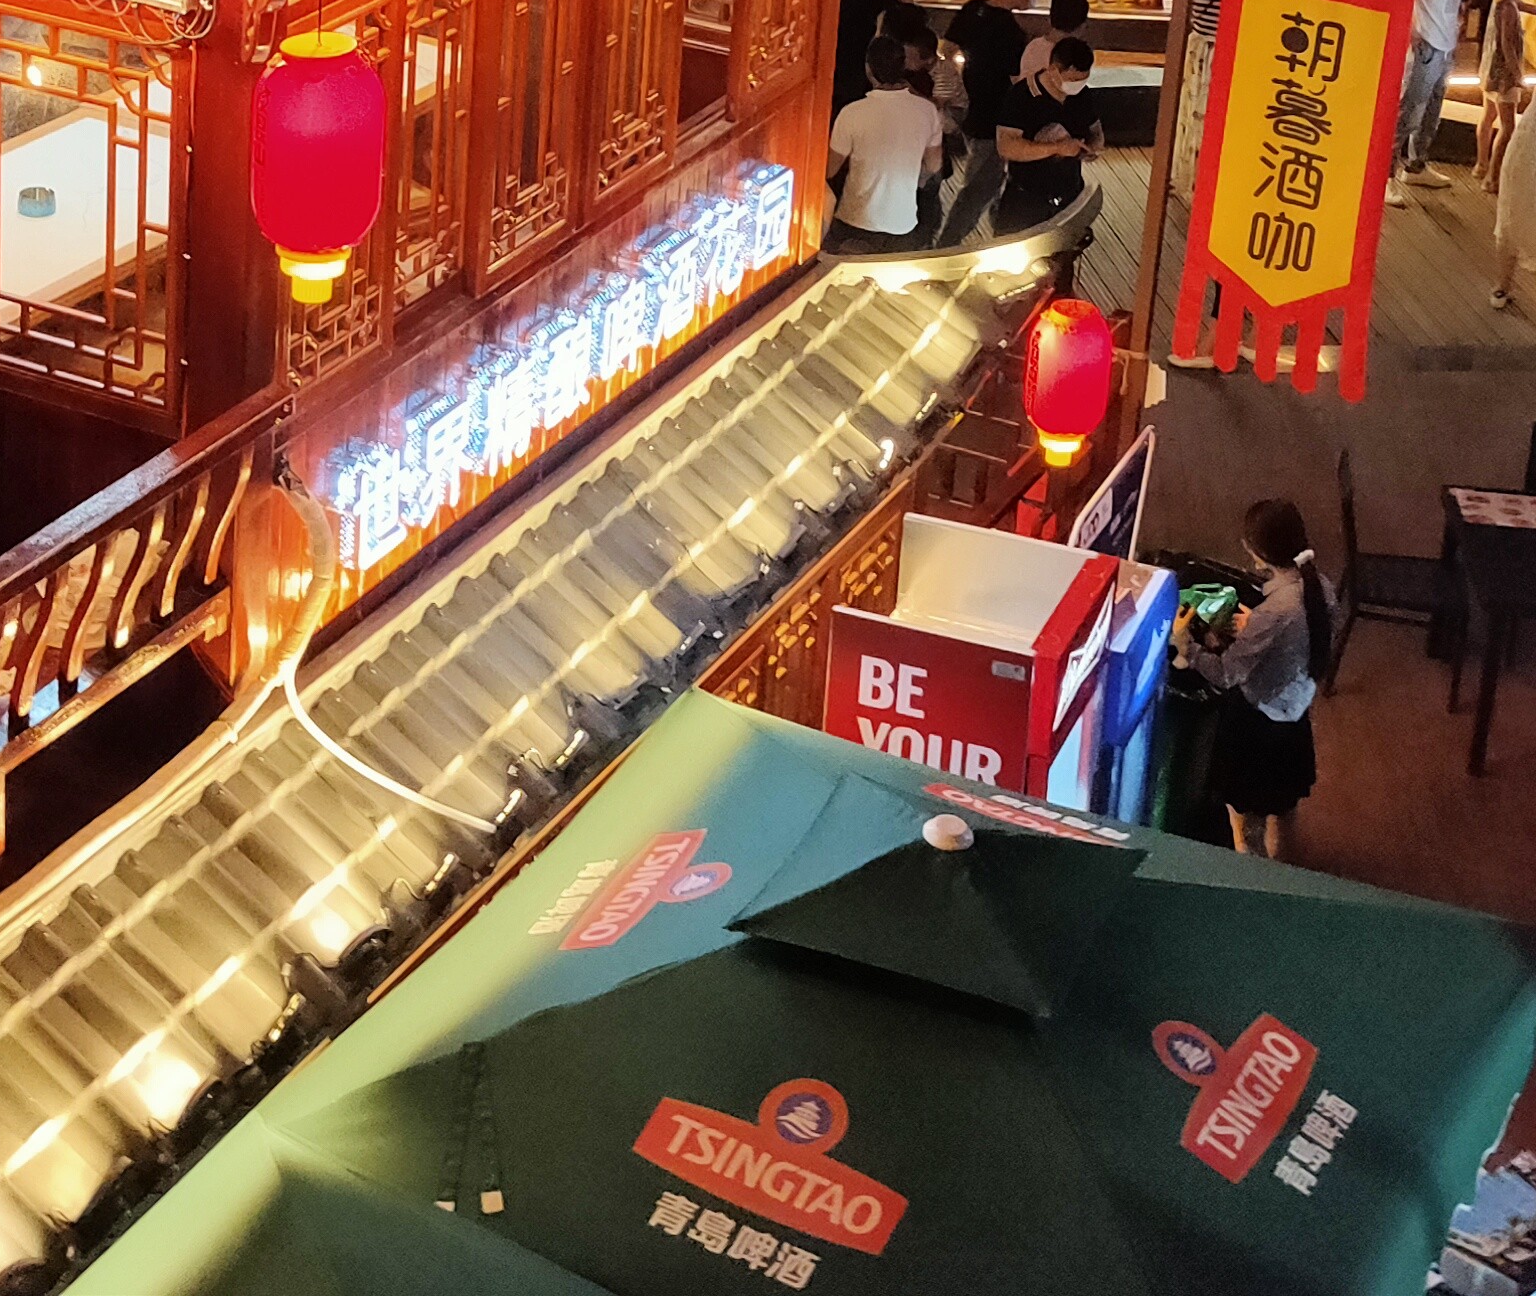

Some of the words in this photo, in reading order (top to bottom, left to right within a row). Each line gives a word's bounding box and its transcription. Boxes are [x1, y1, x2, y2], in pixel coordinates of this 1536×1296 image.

[1247, 12, 1347, 273] 朝暮酒咖
[857, 653, 929, 720] BE
[856, 716, 1004, 787] YOUR
[580, 836, 692, 941] TSINGTAO
[1196, 1030, 1301, 1161] TSINGTAO
[666, 1114, 883, 1235] TSINGTAO
